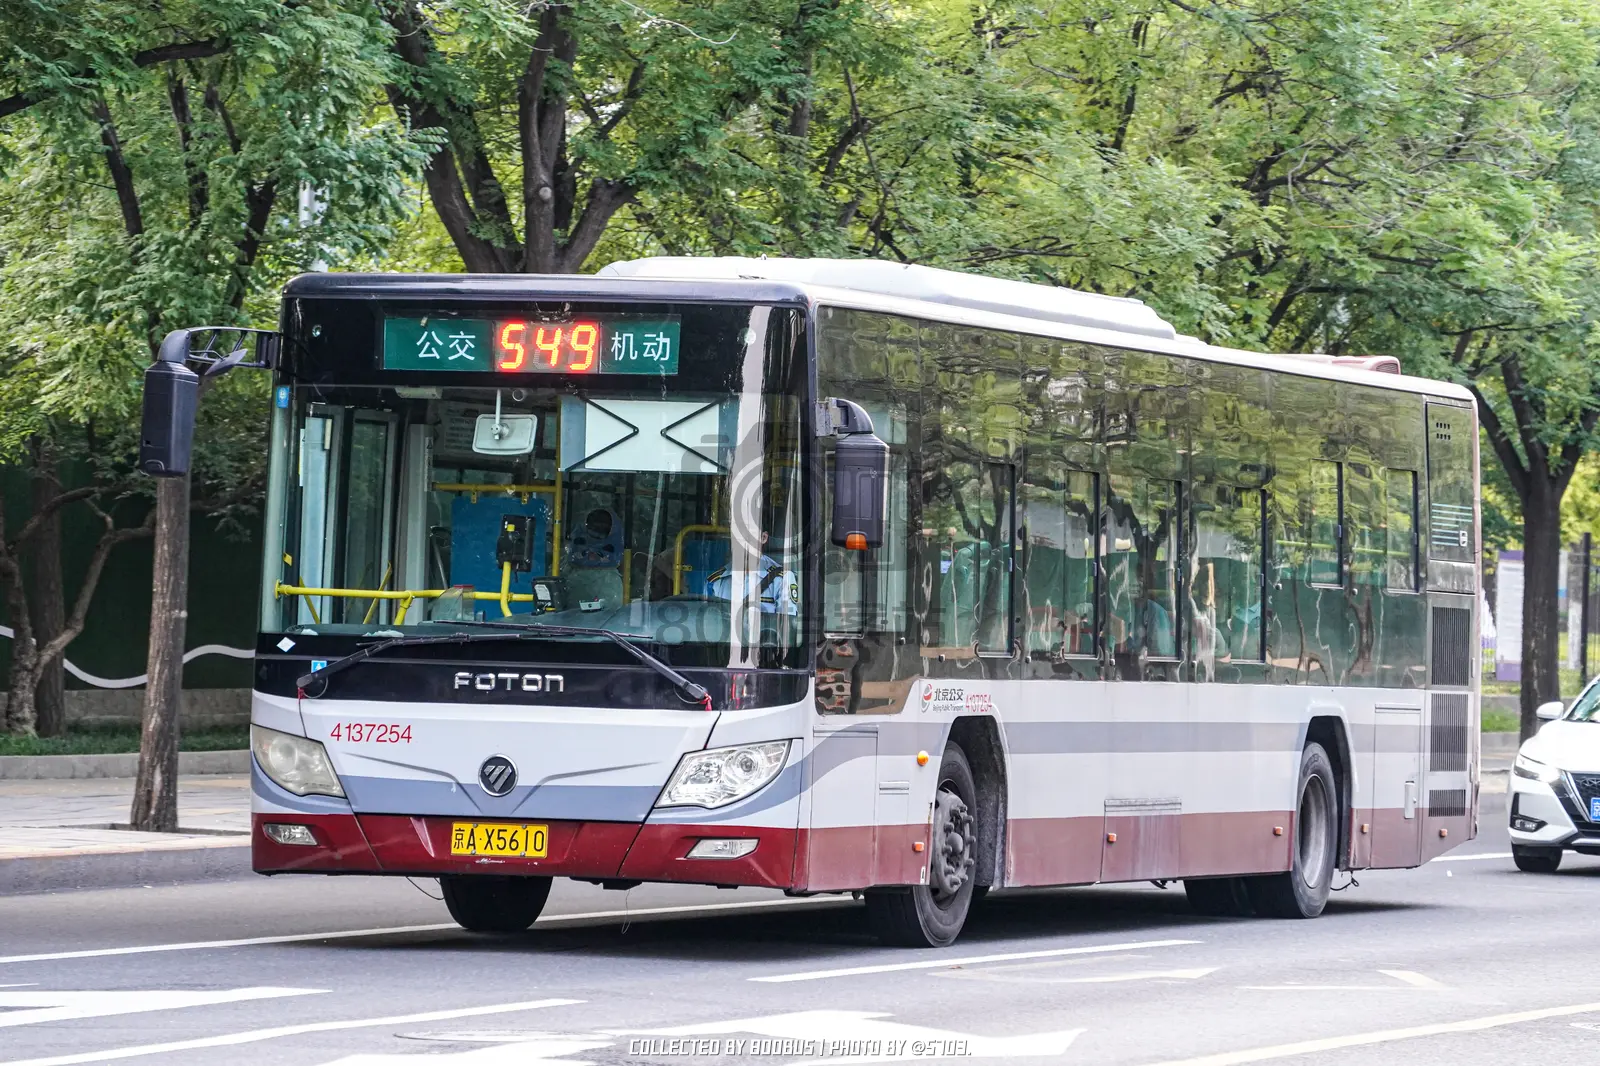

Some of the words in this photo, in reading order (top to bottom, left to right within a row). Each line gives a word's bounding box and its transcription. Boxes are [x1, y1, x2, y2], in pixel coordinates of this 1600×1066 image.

[416, 330, 476, 361] 公交
[499, 322, 597, 371] 549
[611, 331, 671, 361] 机动
[453, 671, 564, 693] FOTON
[934, 688, 964, 702] 北京公交
[330, 722, 412, 744] 4137254
